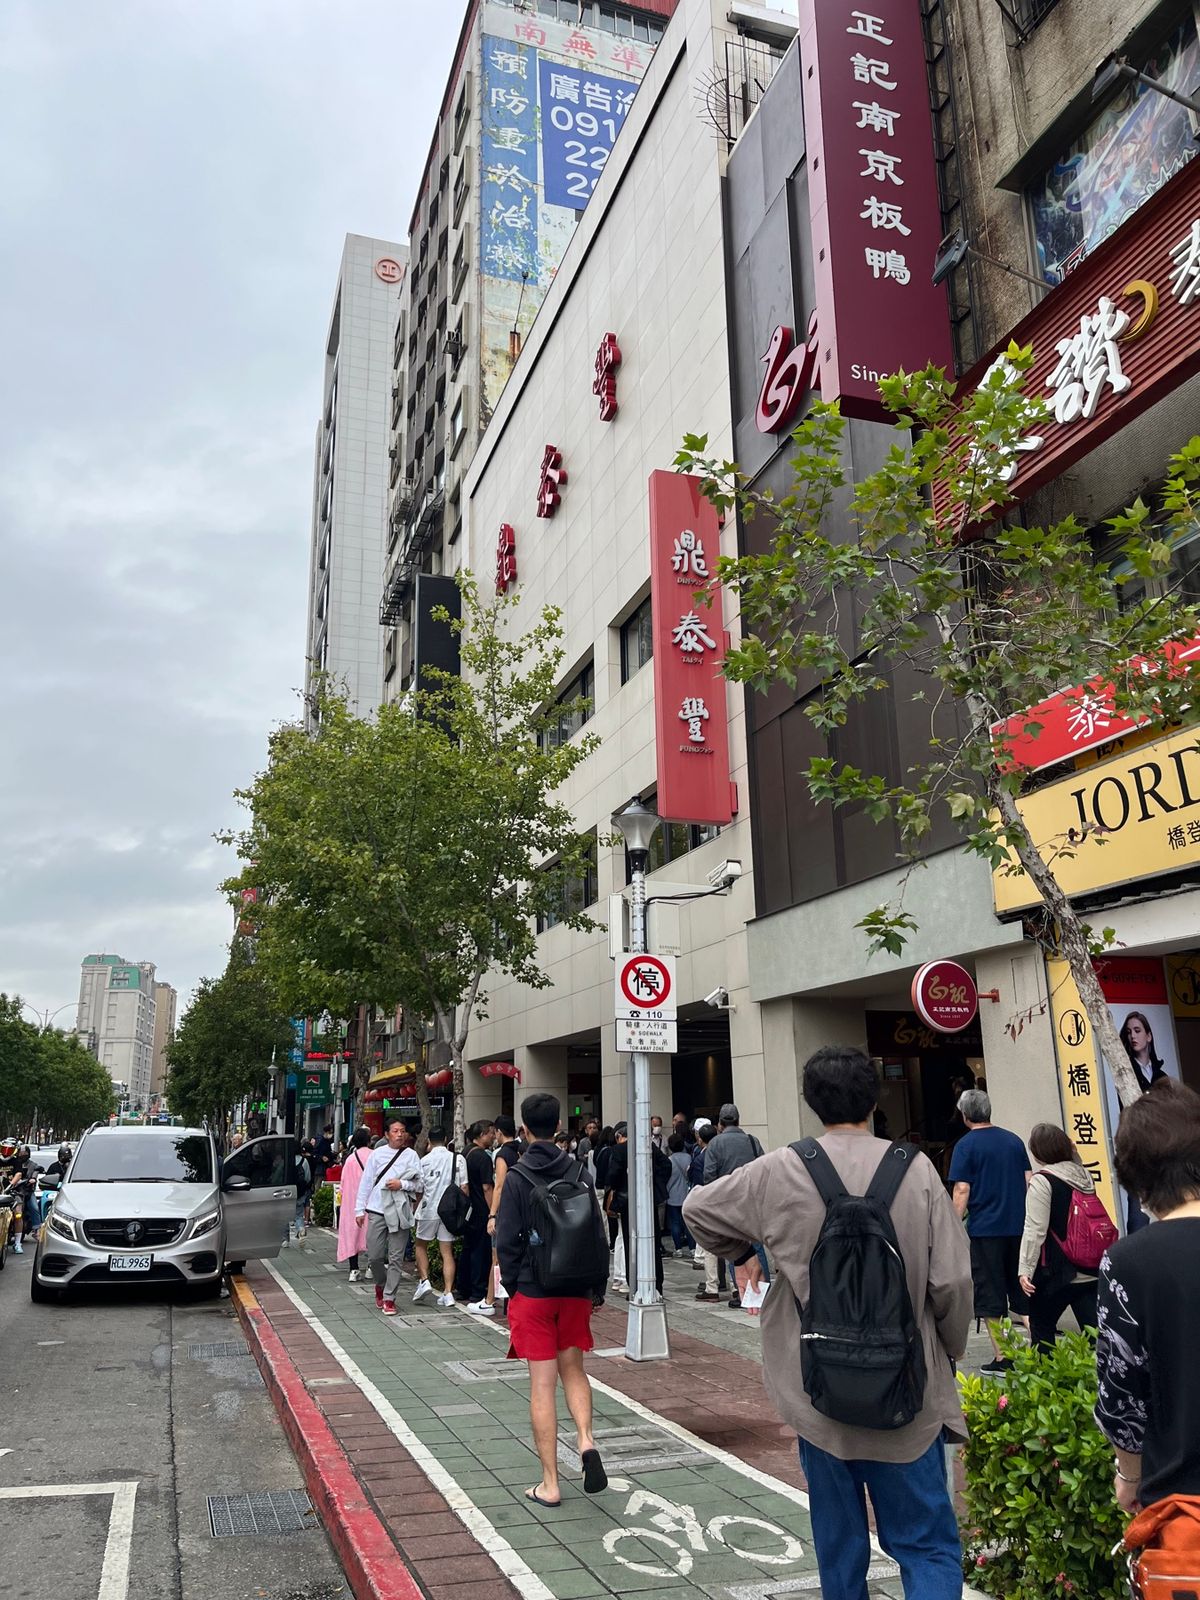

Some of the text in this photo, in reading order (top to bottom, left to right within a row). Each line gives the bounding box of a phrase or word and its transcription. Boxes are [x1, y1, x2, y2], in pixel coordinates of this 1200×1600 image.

[514, 20, 658, 72] 南無準
[846, 10, 911, 286] 正記南京板鴨
[565, 171, 599, 199] 2
[671, 529, 717, 742] 鼎泰豐
[633, 967, 660, 997] 停
[646, 1010, 663, 1019] 110
